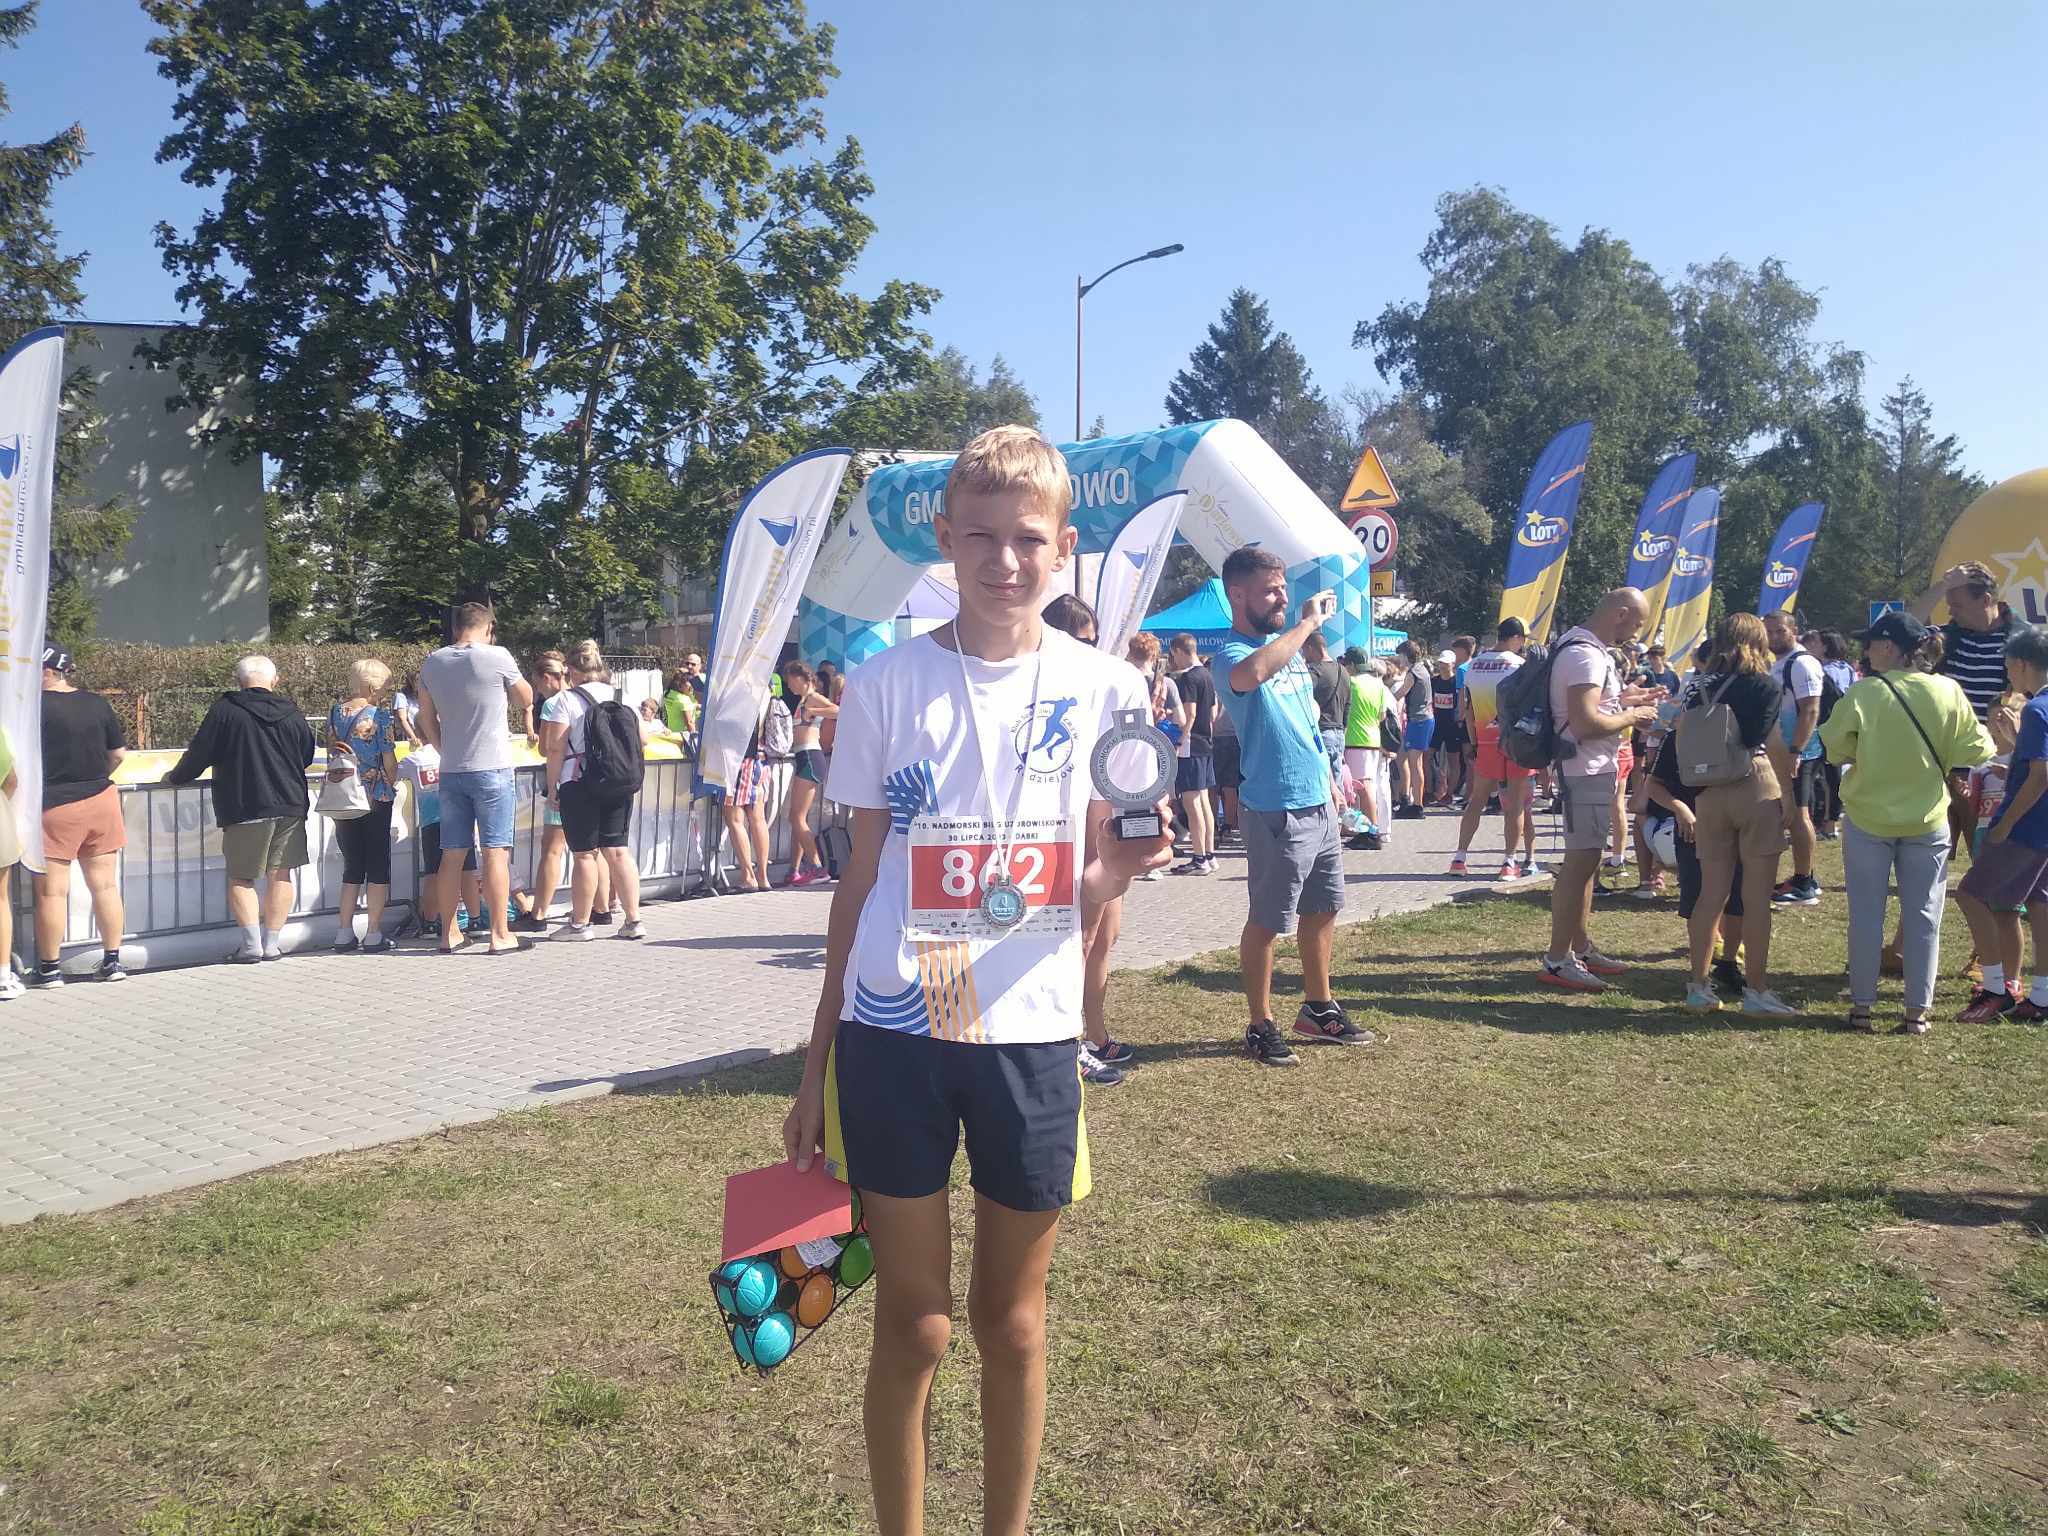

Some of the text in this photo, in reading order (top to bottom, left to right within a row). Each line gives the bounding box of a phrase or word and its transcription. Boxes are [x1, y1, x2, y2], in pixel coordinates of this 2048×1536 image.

[932, 821, 980, 829] NADMORSKI
[960, 833, 984, 841] LIPCA
[941, 846, 1046, 898] 862
